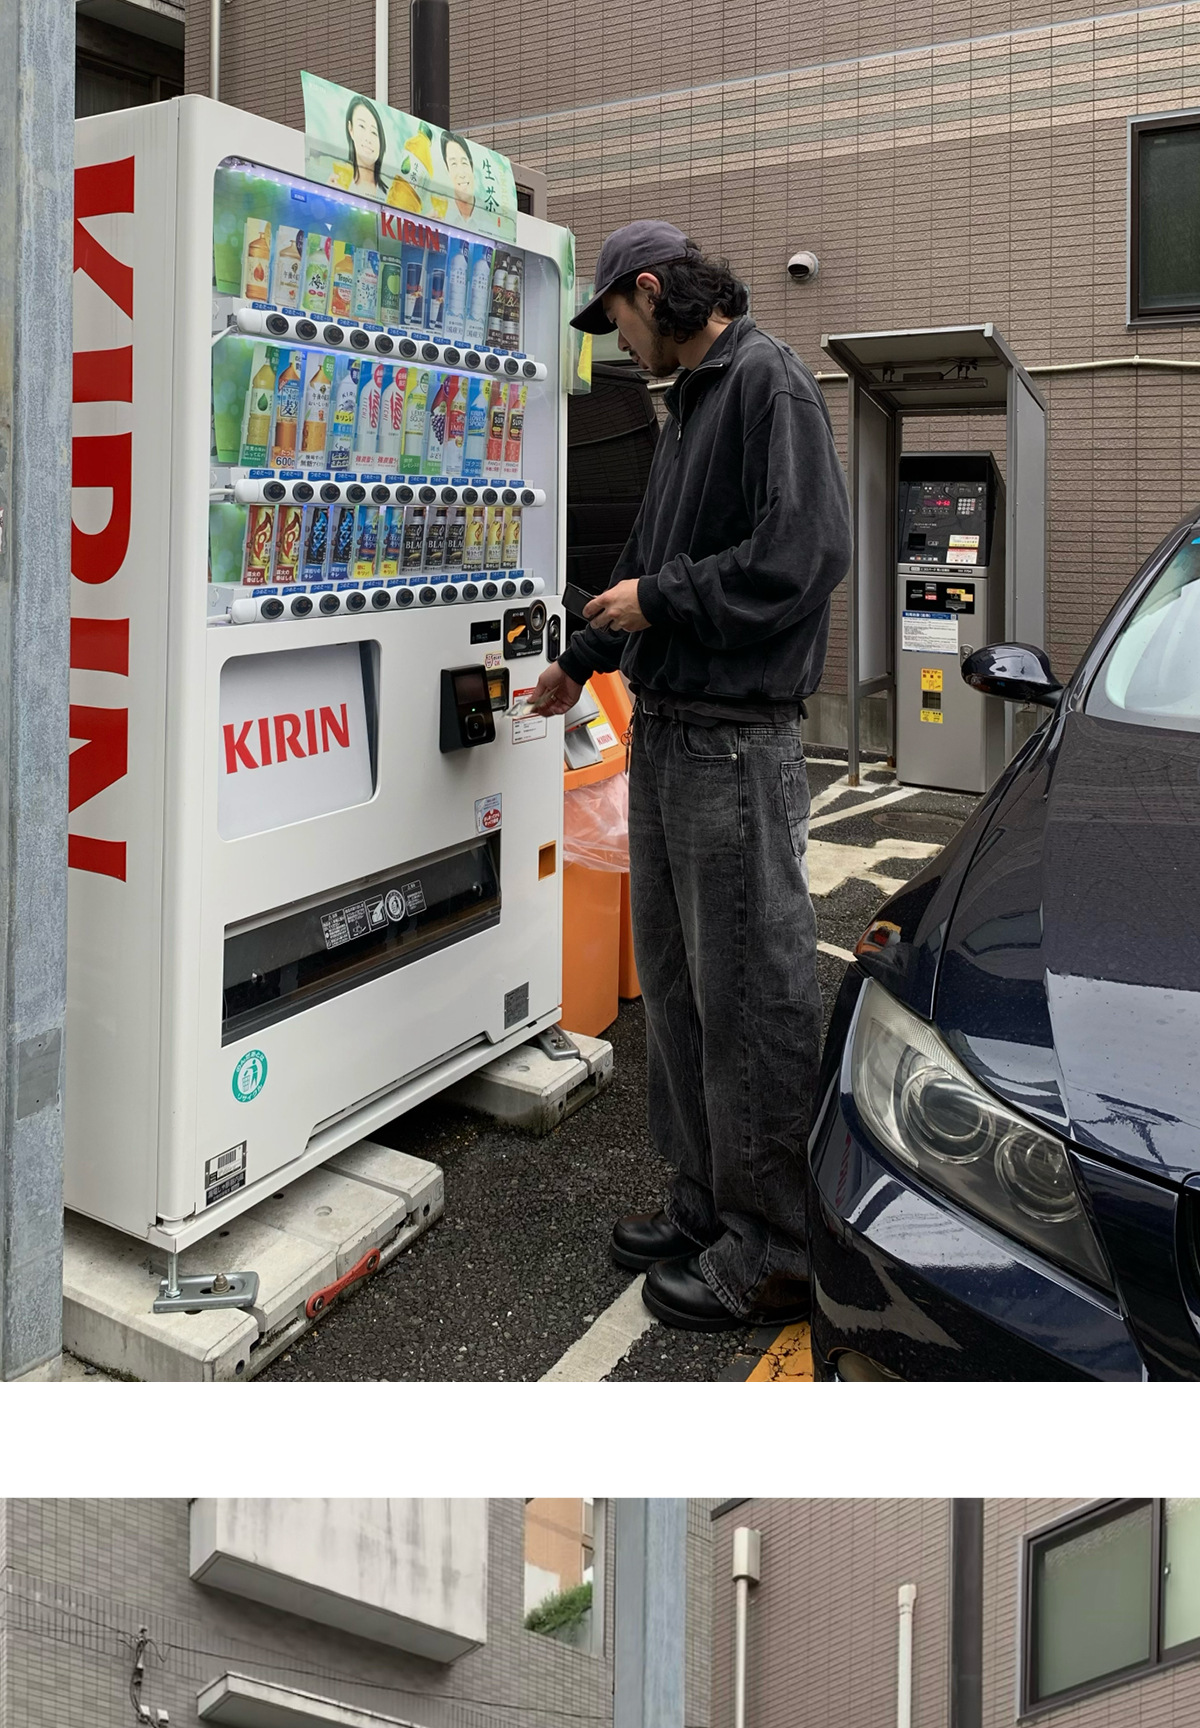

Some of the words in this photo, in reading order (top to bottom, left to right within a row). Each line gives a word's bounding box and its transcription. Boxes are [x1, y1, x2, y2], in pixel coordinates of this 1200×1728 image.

[482, 158, 500, 213] 生茶
[380, 211, 441, 252] KIRIN
[223, 703, 350, 774] KIRIN
